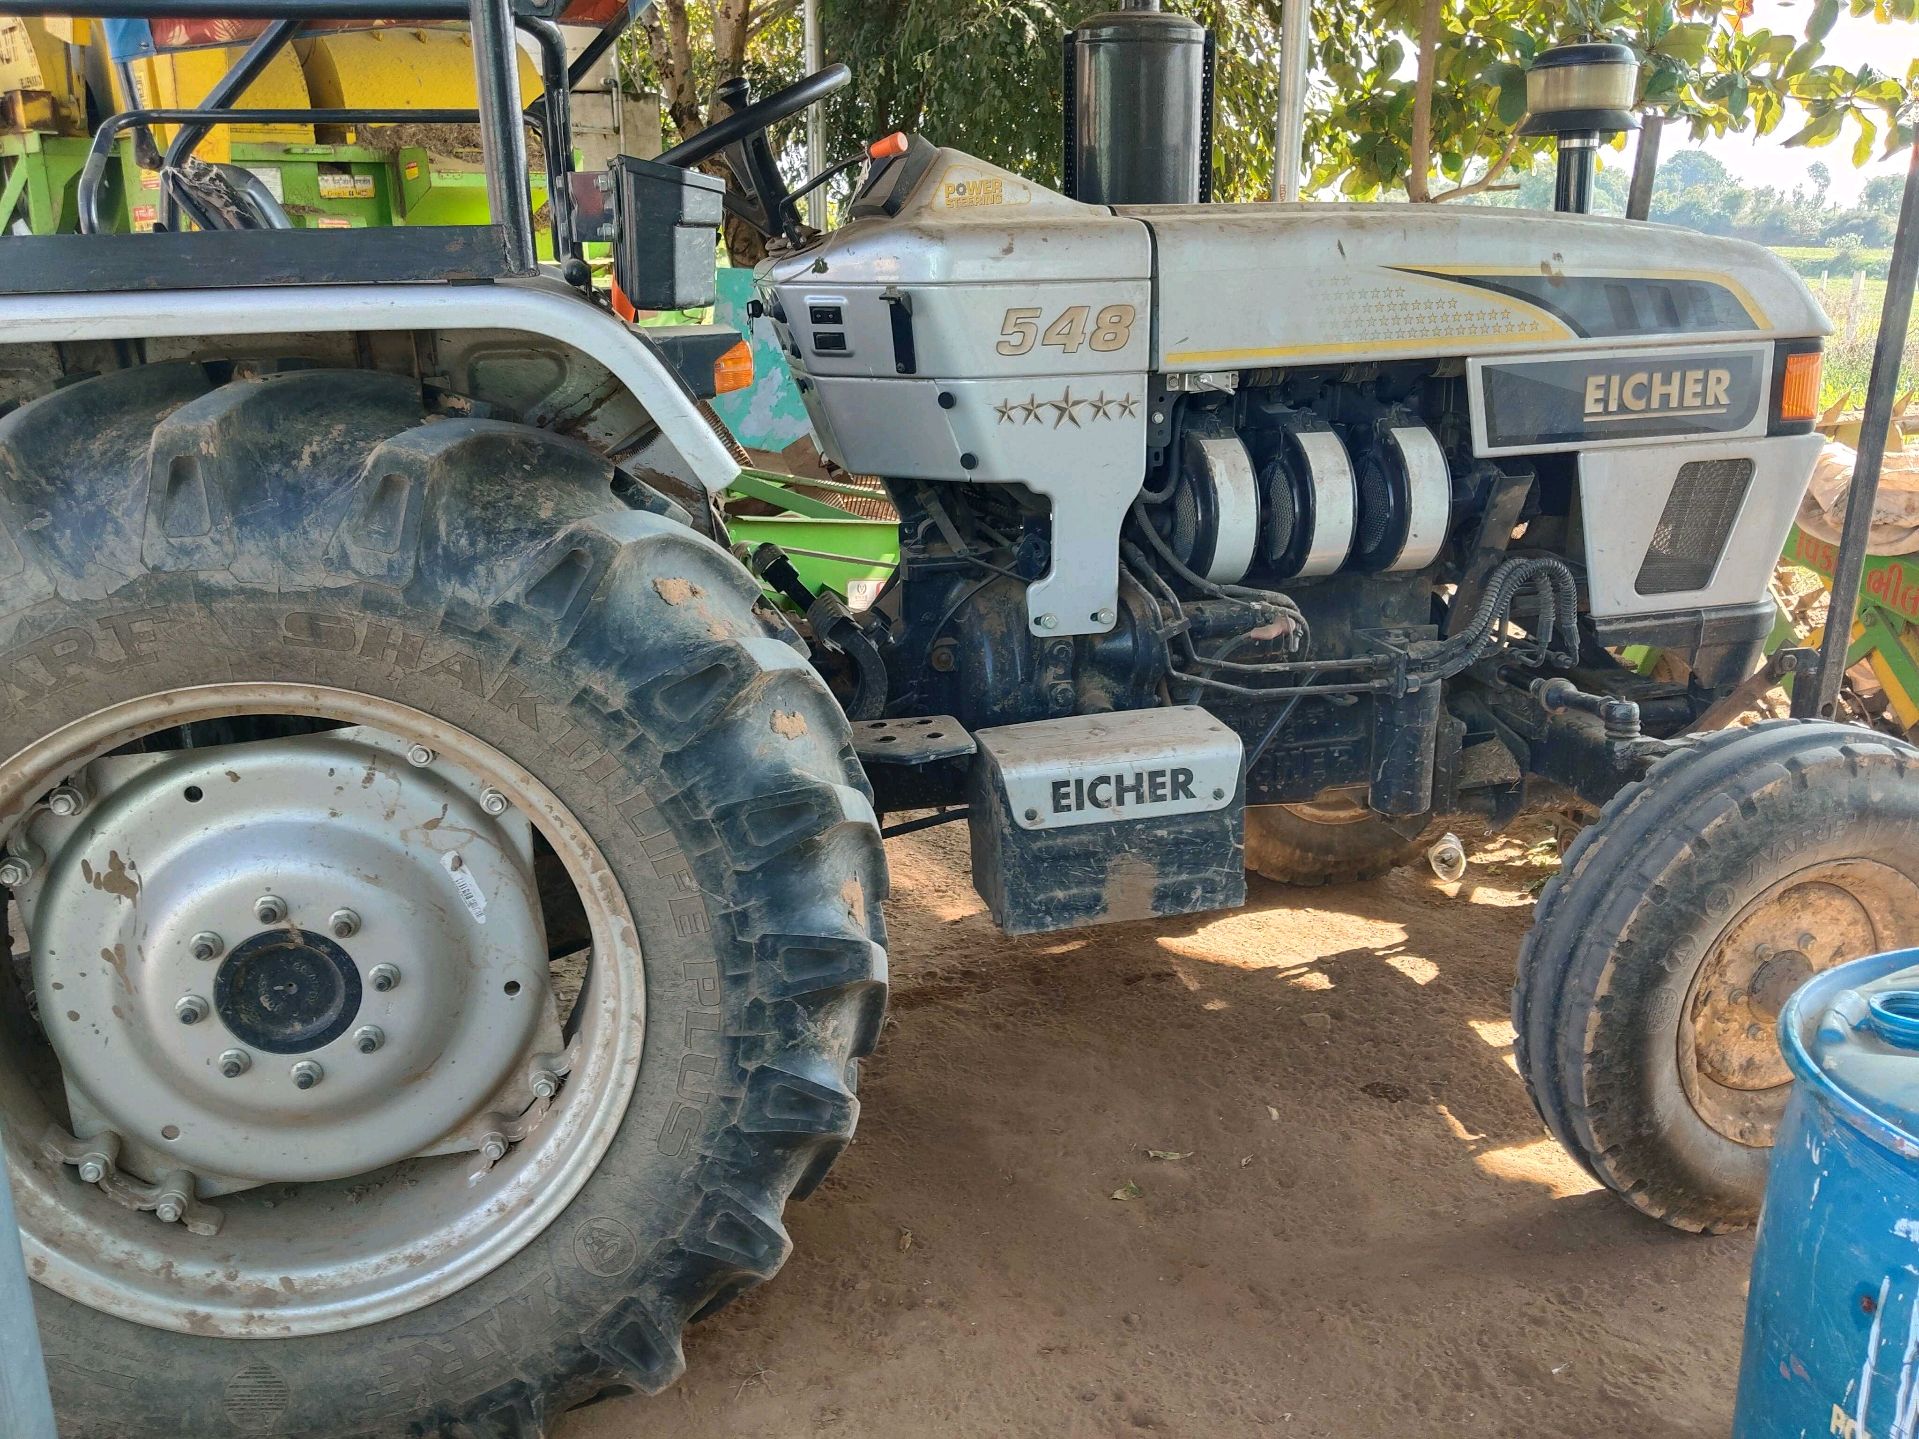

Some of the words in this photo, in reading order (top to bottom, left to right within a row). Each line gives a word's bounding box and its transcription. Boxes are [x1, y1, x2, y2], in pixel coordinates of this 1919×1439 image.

[944, 177, 1003, 197] POWER
[945, 194, 1003, 208] STEERING
[996, 304, 1136, 356] 548
[1584, 368, 1731, 415] EICHER
[283, 610, 625, 784] SHAKTI
[1051, 766, 1198, 814] EICHER
[615, 790, 712, 938] LIFE
[656, 958, 721, 1160] PLUS
